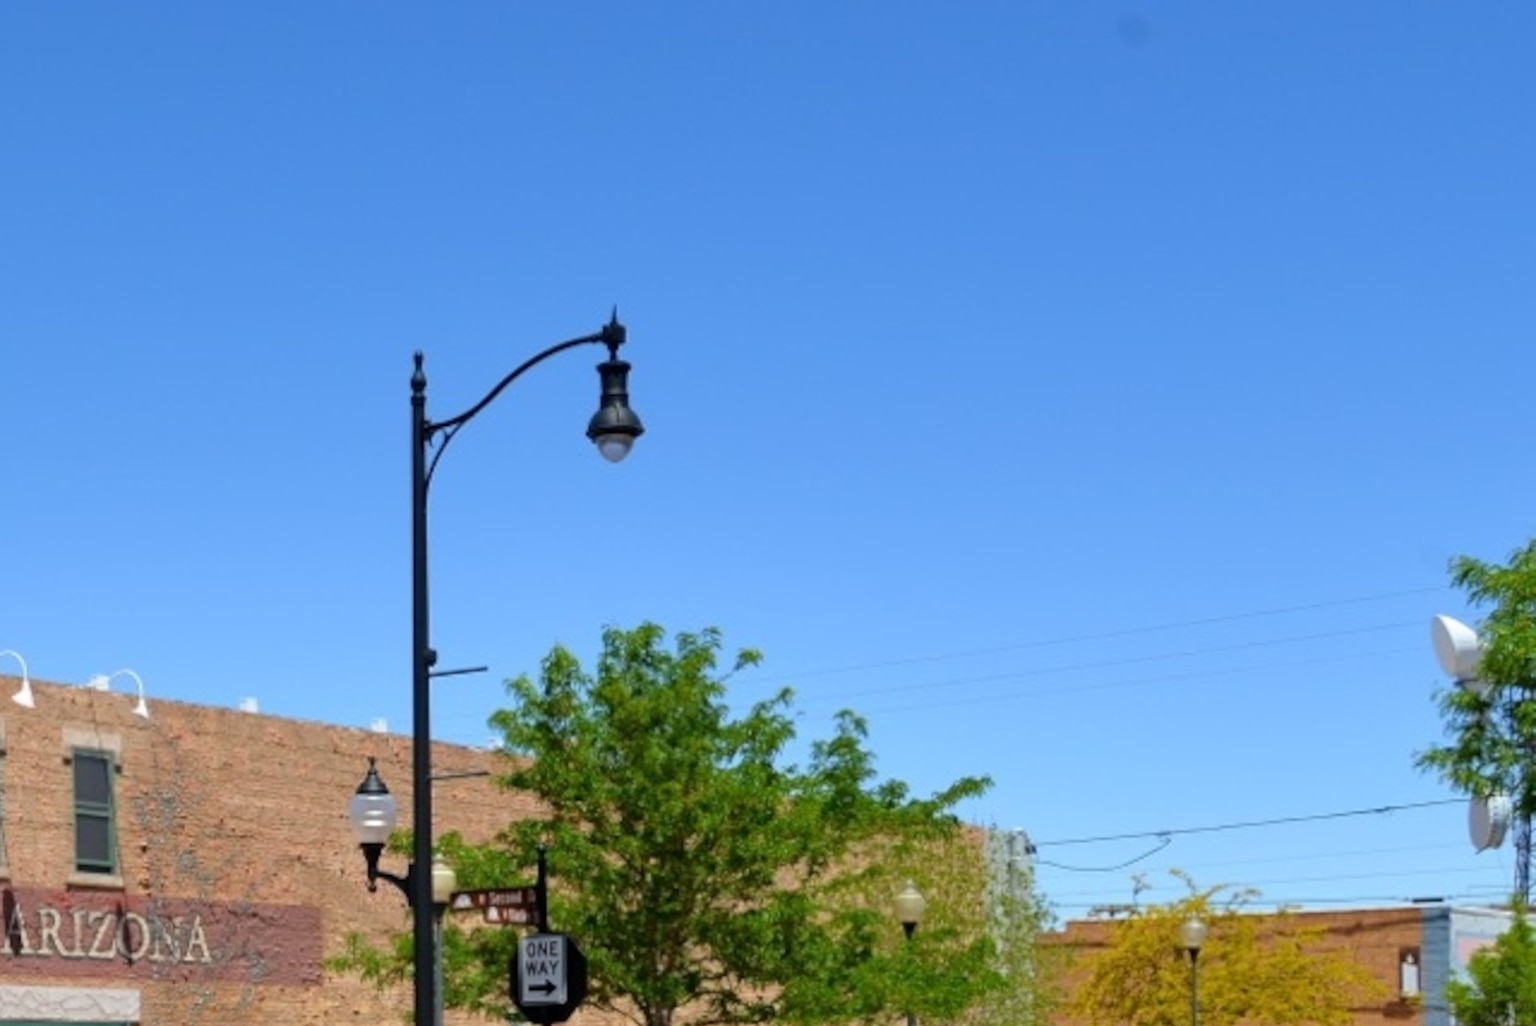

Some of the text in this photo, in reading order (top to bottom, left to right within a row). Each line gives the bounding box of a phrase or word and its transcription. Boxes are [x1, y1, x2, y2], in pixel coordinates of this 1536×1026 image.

[0, 902, 212, 963] ARIZONA
[526, 940, 558, 957] ONE
[526, 960, 559, 976] WAY
